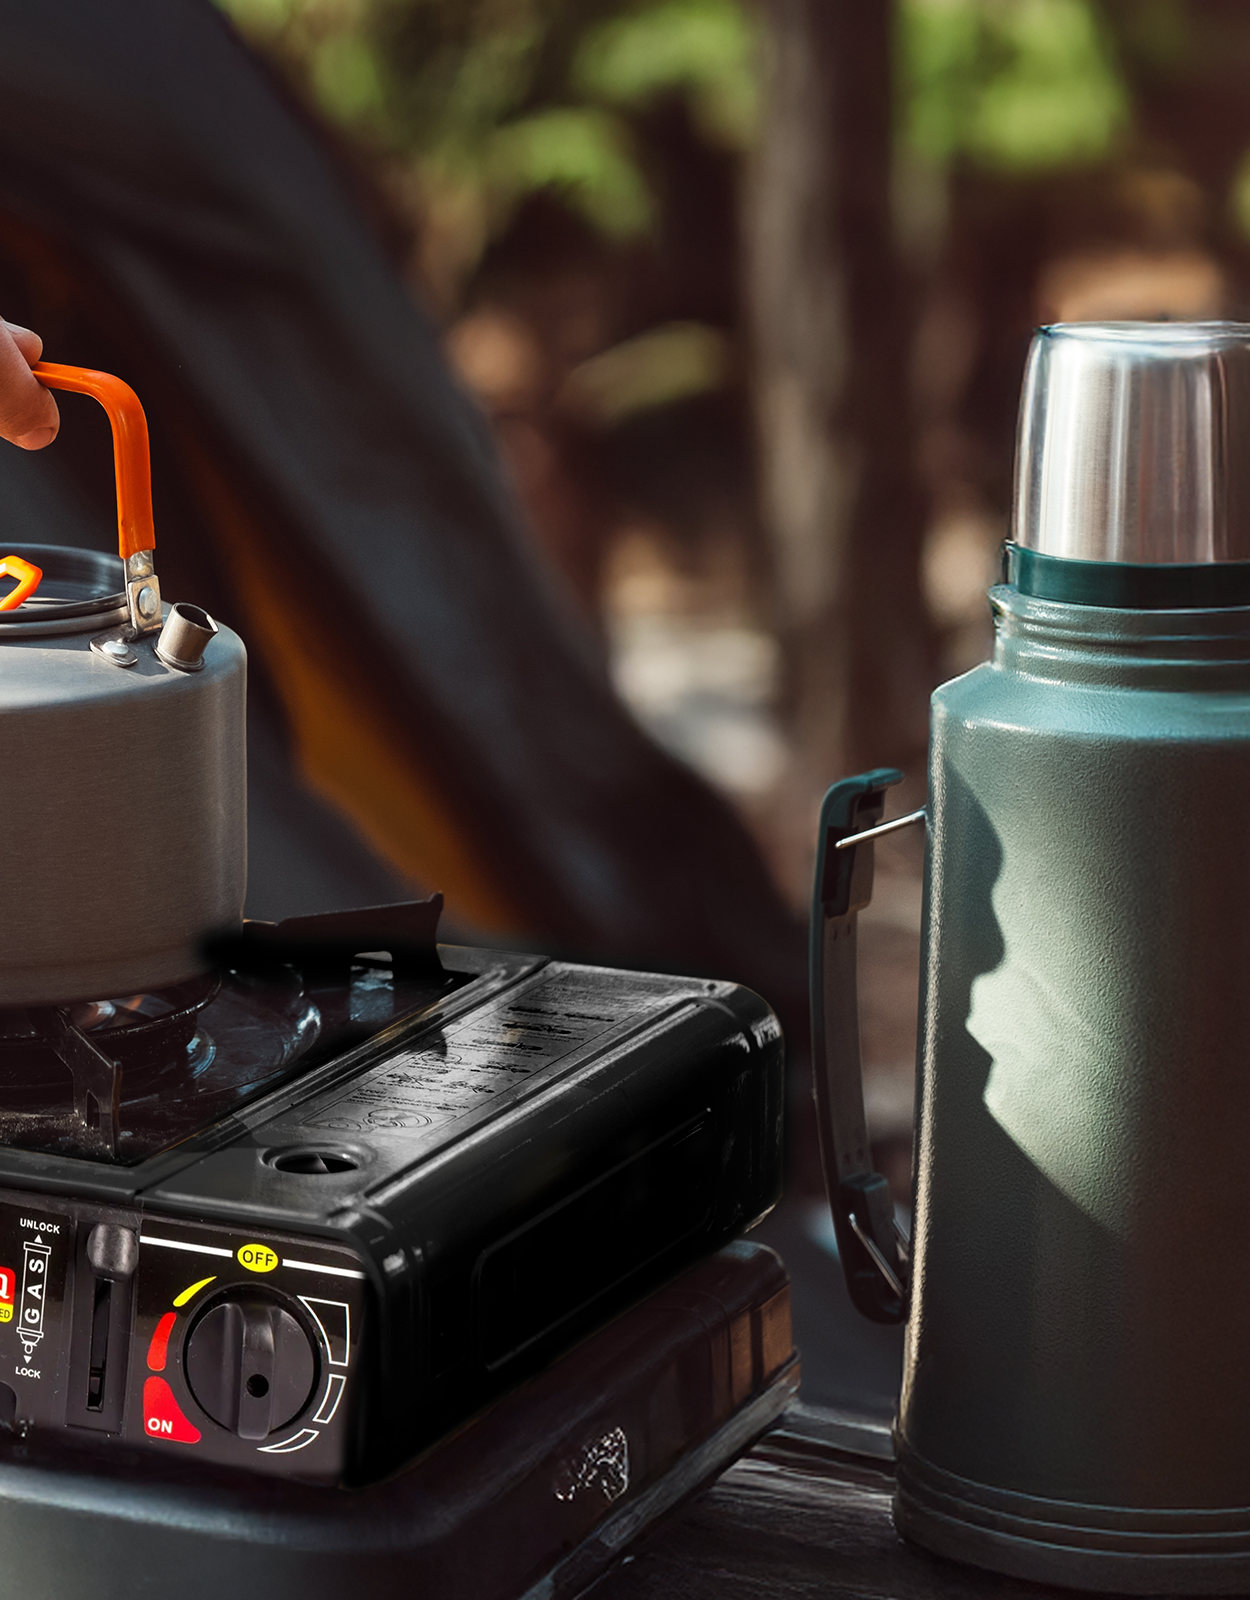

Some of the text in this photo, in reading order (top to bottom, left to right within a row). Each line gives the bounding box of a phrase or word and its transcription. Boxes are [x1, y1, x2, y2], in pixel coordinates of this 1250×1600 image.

[19, 1218, 60, 1235] UNLOCK
[242, 1250, 274, 1266] OFF
[25, 1258, 45, 1324] GAS
[14, 1366, 41, 1380] LOCK
[147, 1417, 173, 1434] ON
